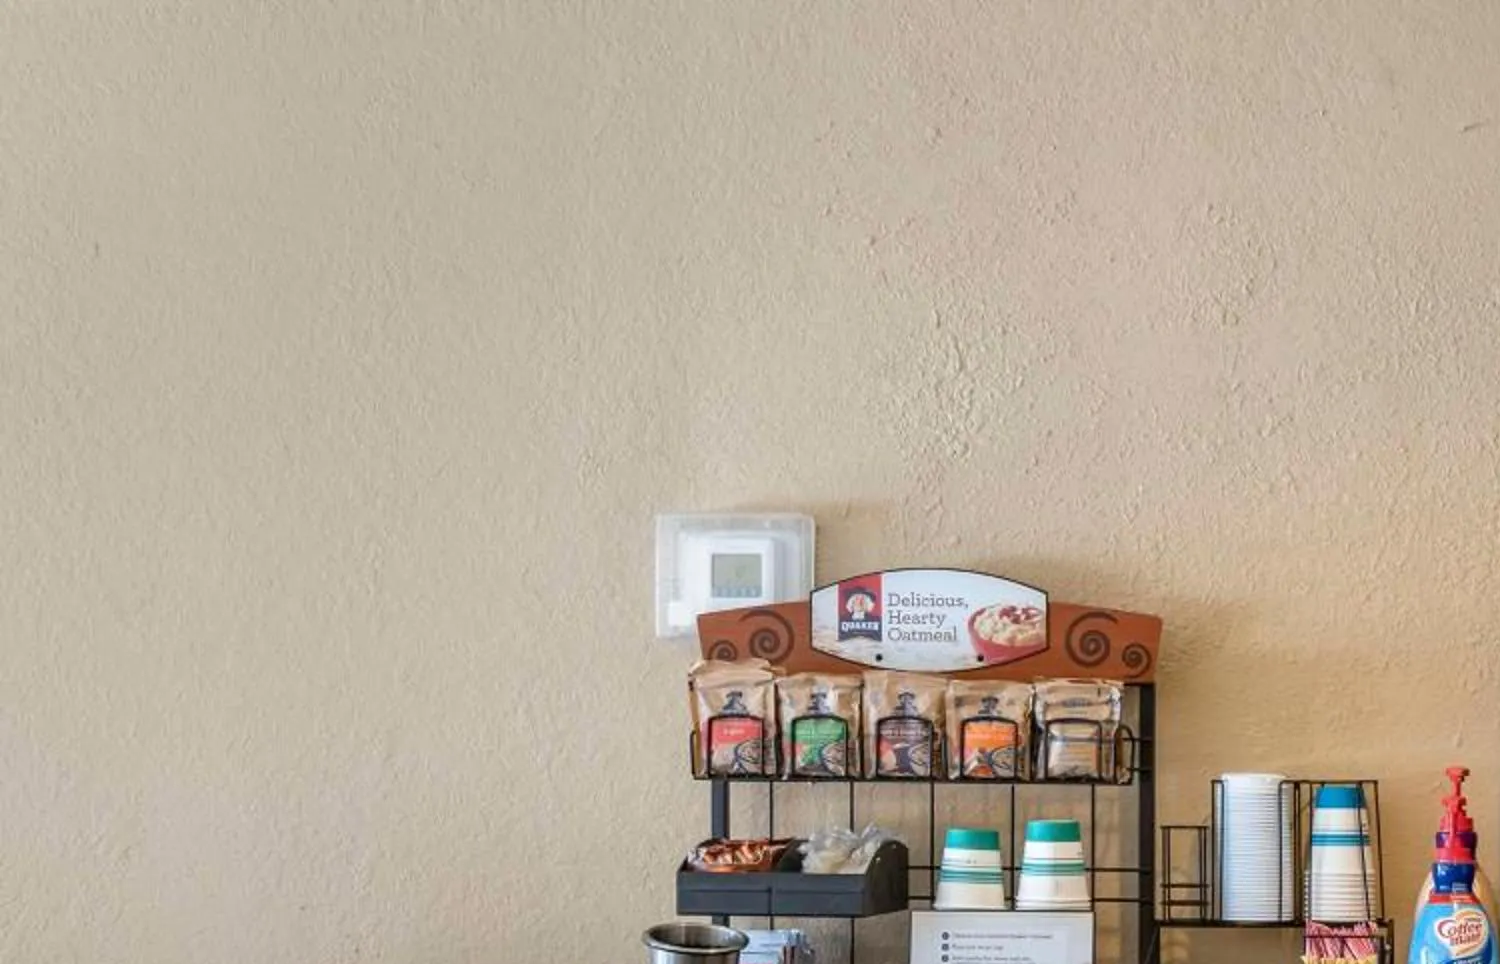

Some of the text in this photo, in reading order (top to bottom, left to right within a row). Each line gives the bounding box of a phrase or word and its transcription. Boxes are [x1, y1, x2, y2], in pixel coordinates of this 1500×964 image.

[887, 591, 969, 608] Delicious,
[841, 621, 880, 632] QUAKER
[887, 609, 947, 628] Hearty
[887, 626, 957, 641] Oatmeal
[1437, 919, 1482, 938] Coffee
